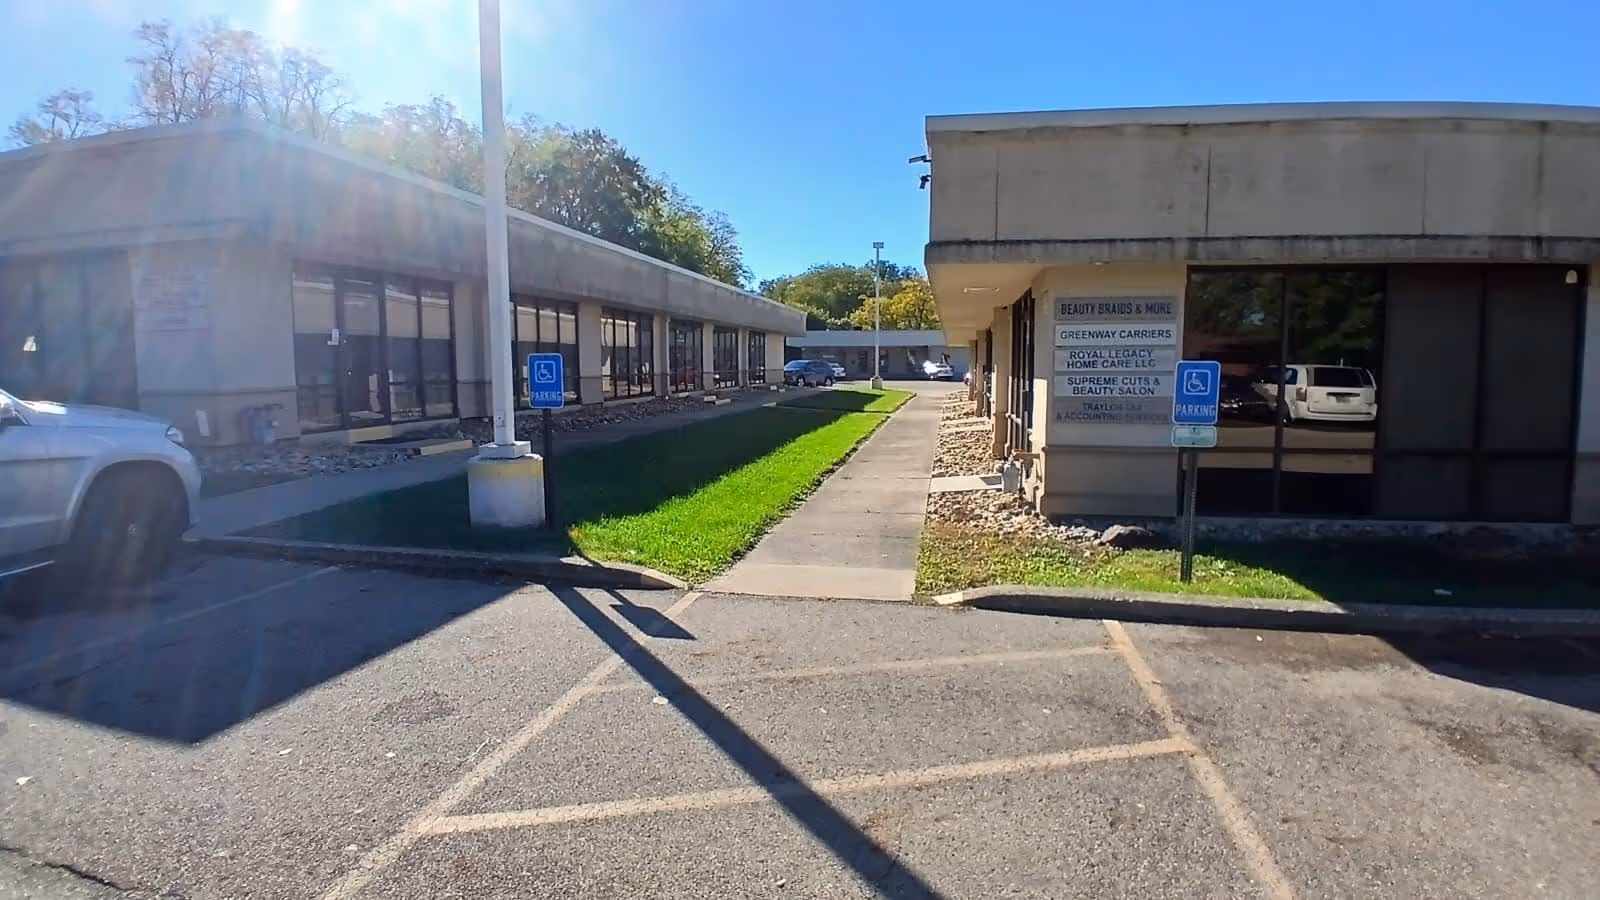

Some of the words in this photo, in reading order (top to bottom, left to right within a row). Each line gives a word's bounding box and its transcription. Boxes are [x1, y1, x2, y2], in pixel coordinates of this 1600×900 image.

[1061, 303, 1094, 316] BEAUTY
[1100, 303, 1132, 315] BRAIDS
[1135, 304, 1142, 314] &
[1145, 303, 1171, 315] MORE
[1060, 330, 1116, 340] GREENWAY
[1119, 329, 1171, 339] CARRIERS
[1069, 350, 1105, 360] ROYAL
[1108, 349, 1152, 359] LEGACY
[1067, 360, 1098, 369] HOME
[1102, 359, 1131, 369] CARE
[1135, 359, 1156, 368] LLC
[1067, 377, 1118, 386] SUPREME
[1122, 377, 1150, 386] CUTS
[1153, 376, 1160, 386] &
[1072, 386, 1114, 395] BEAUTY
[1118, 387, 1155, 395] SALON
[530, 391, 562, 401] PARKING
[1175, 404, 1216, 417] PARKING
